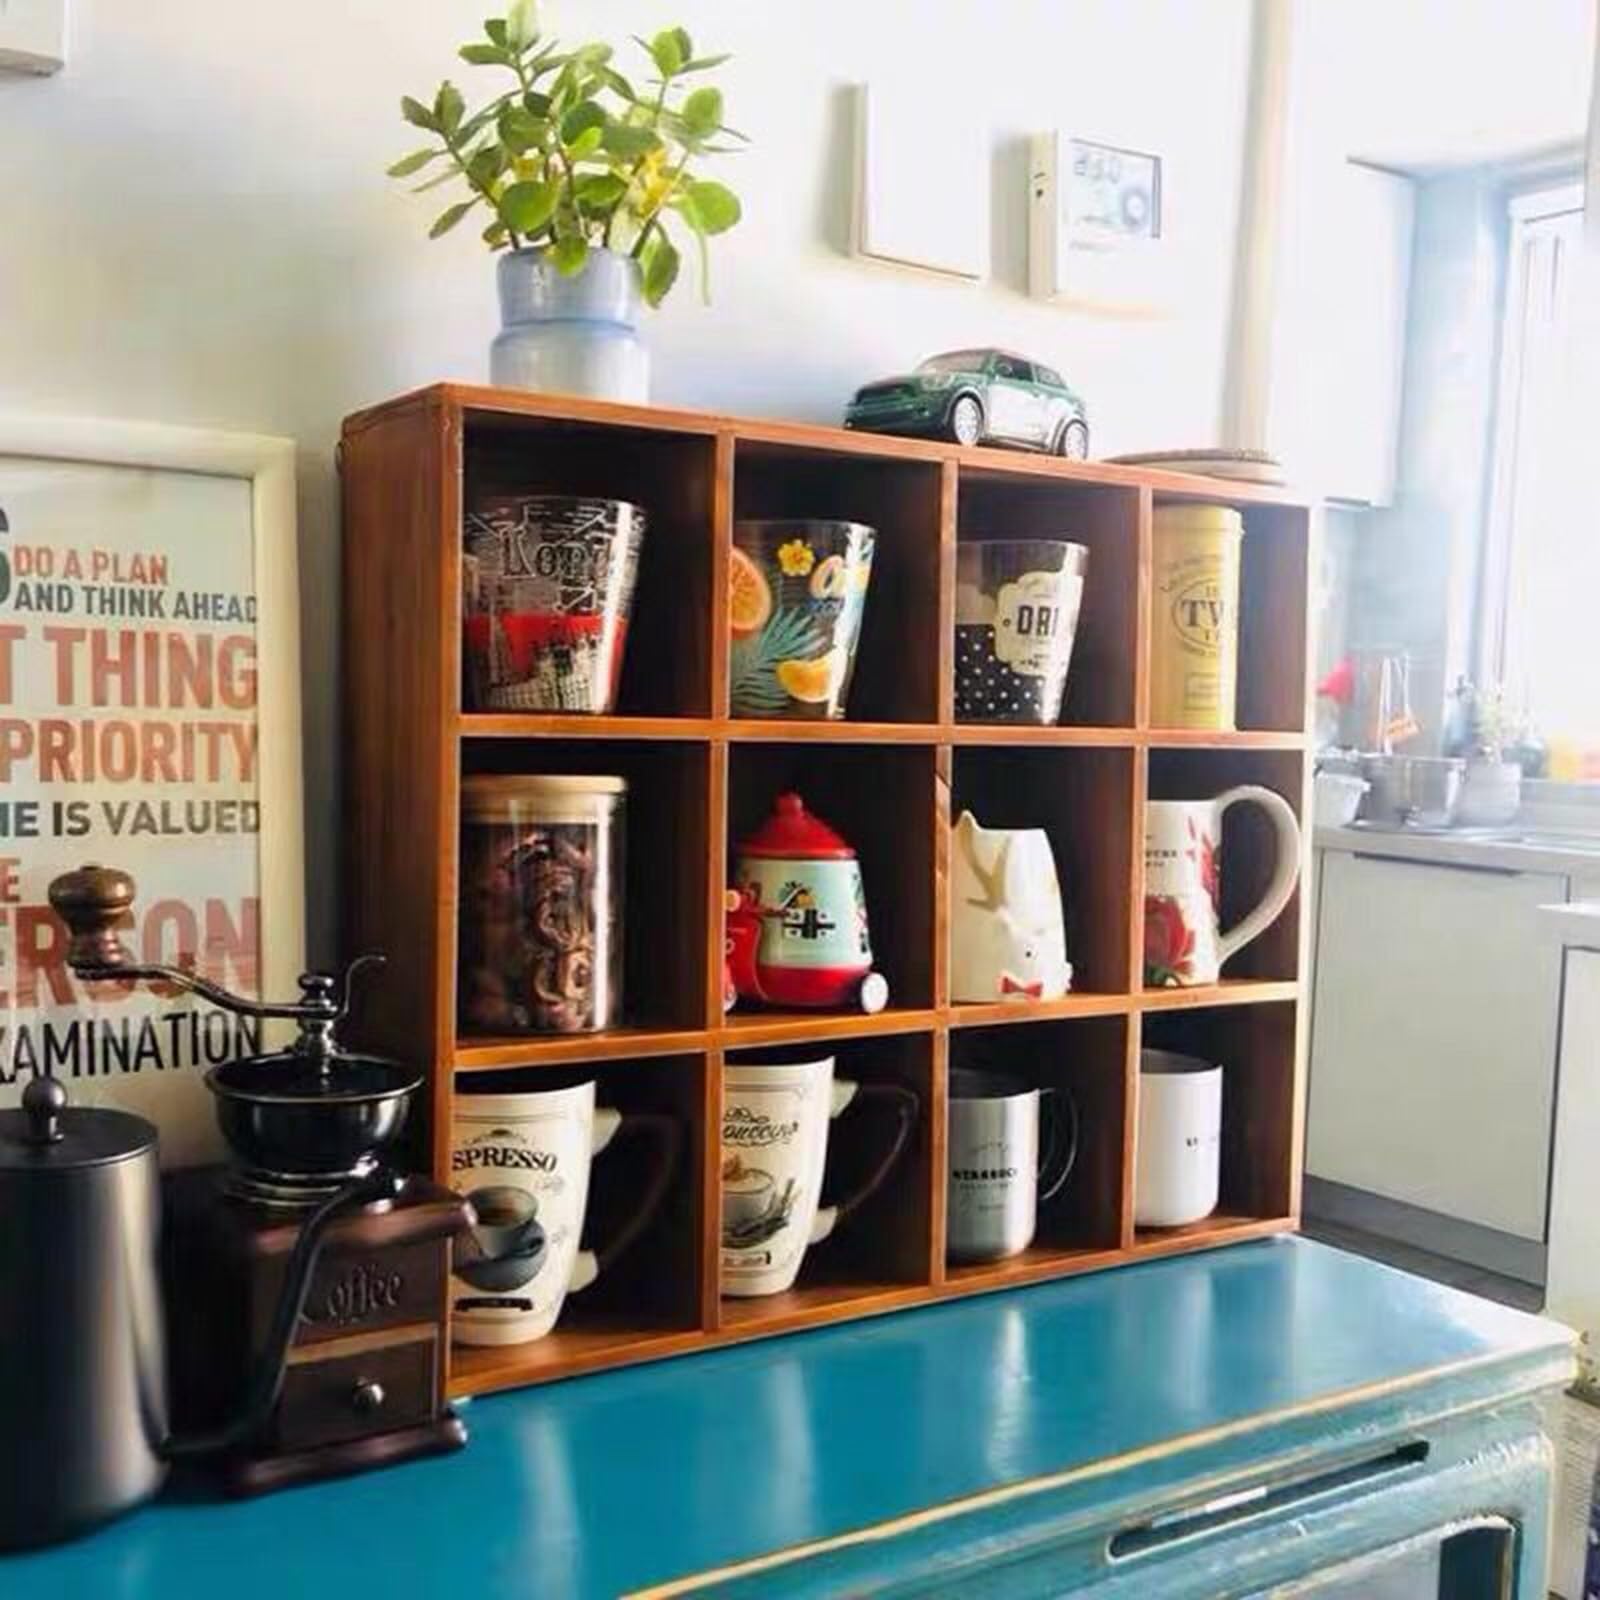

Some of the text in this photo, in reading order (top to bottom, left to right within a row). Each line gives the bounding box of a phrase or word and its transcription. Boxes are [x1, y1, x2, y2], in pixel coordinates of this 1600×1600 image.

[13, 545, 168, 585] DO A PLAN
[14, 583, 258, 623] AND THINK AHEAD
[43, 625, 258, 709] THING
[0, 718, 258, 783] PRIORITY
[53, 802, 90, 836] IS
[101, 801, 260, 835] VALUED
